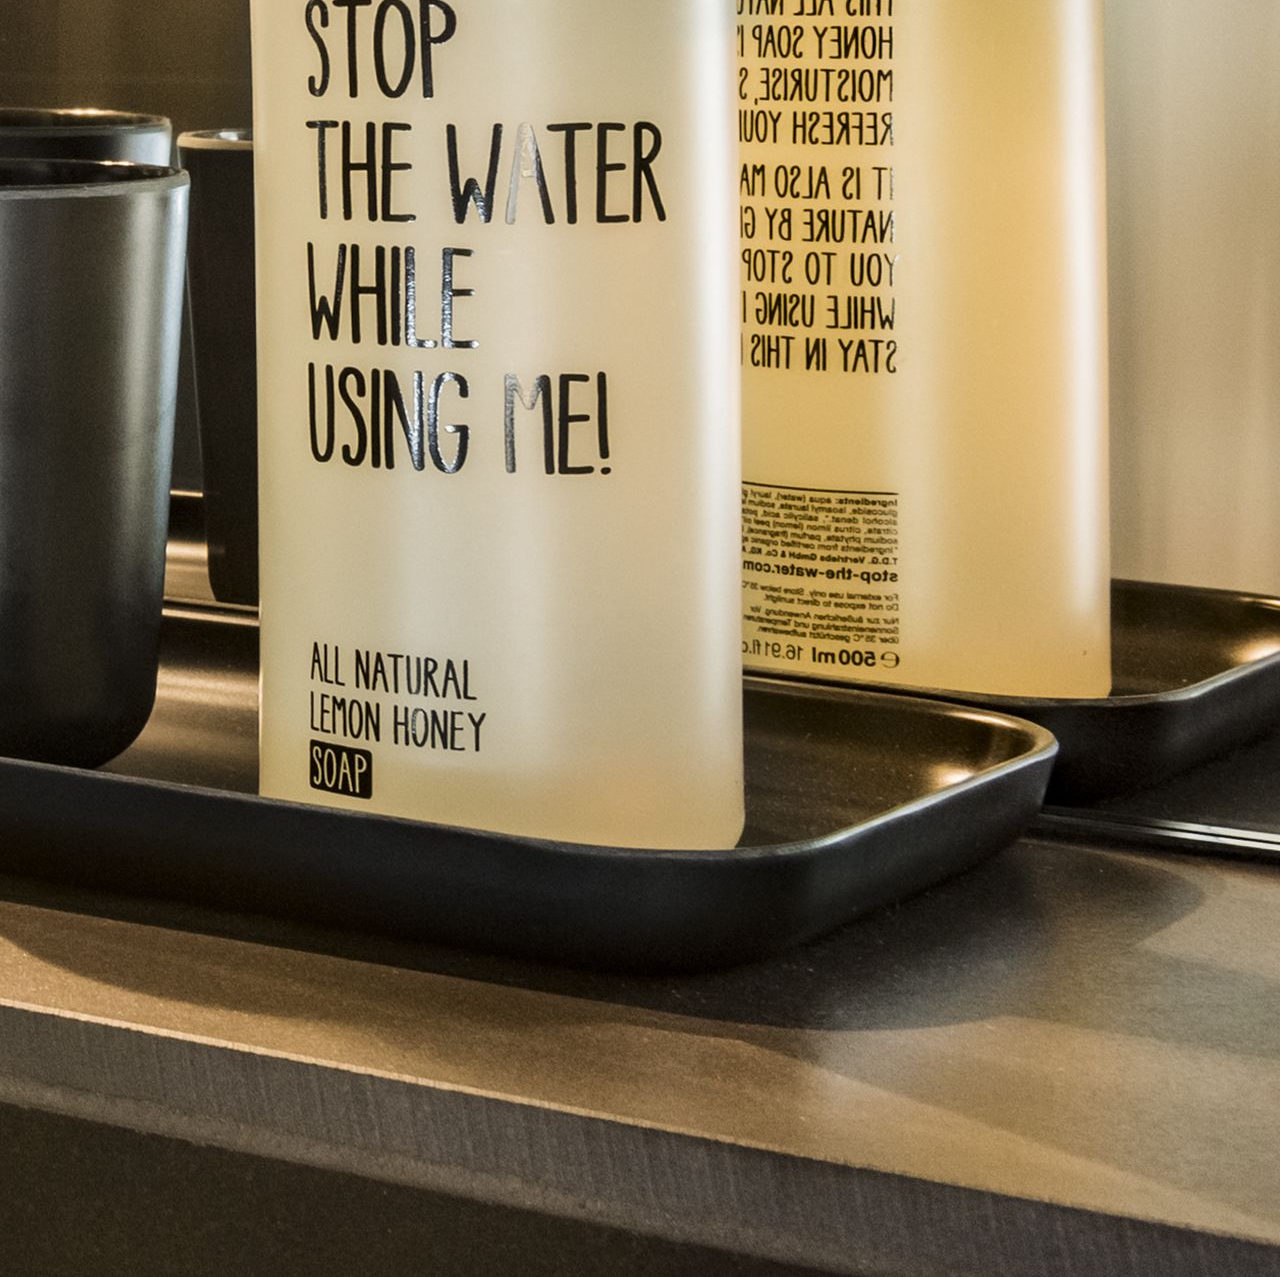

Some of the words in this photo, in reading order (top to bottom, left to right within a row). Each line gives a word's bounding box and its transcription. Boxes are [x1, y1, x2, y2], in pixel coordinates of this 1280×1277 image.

[305, 120, 416, 224] THE
[447, 120, 667, 225] WATER
[306, 243, 479, 349] WHILE
[306, 363, 470, 475] USING
[504, 371, 612, 476] ME!
[311, 642, 345, 688] ALL
[354, 648, 477, 701] NATURAL
[310, 692, 380, 744] LEMON
[391, 707, 487, 753] HONEY
[313, 745, 367, 792] SOAP
